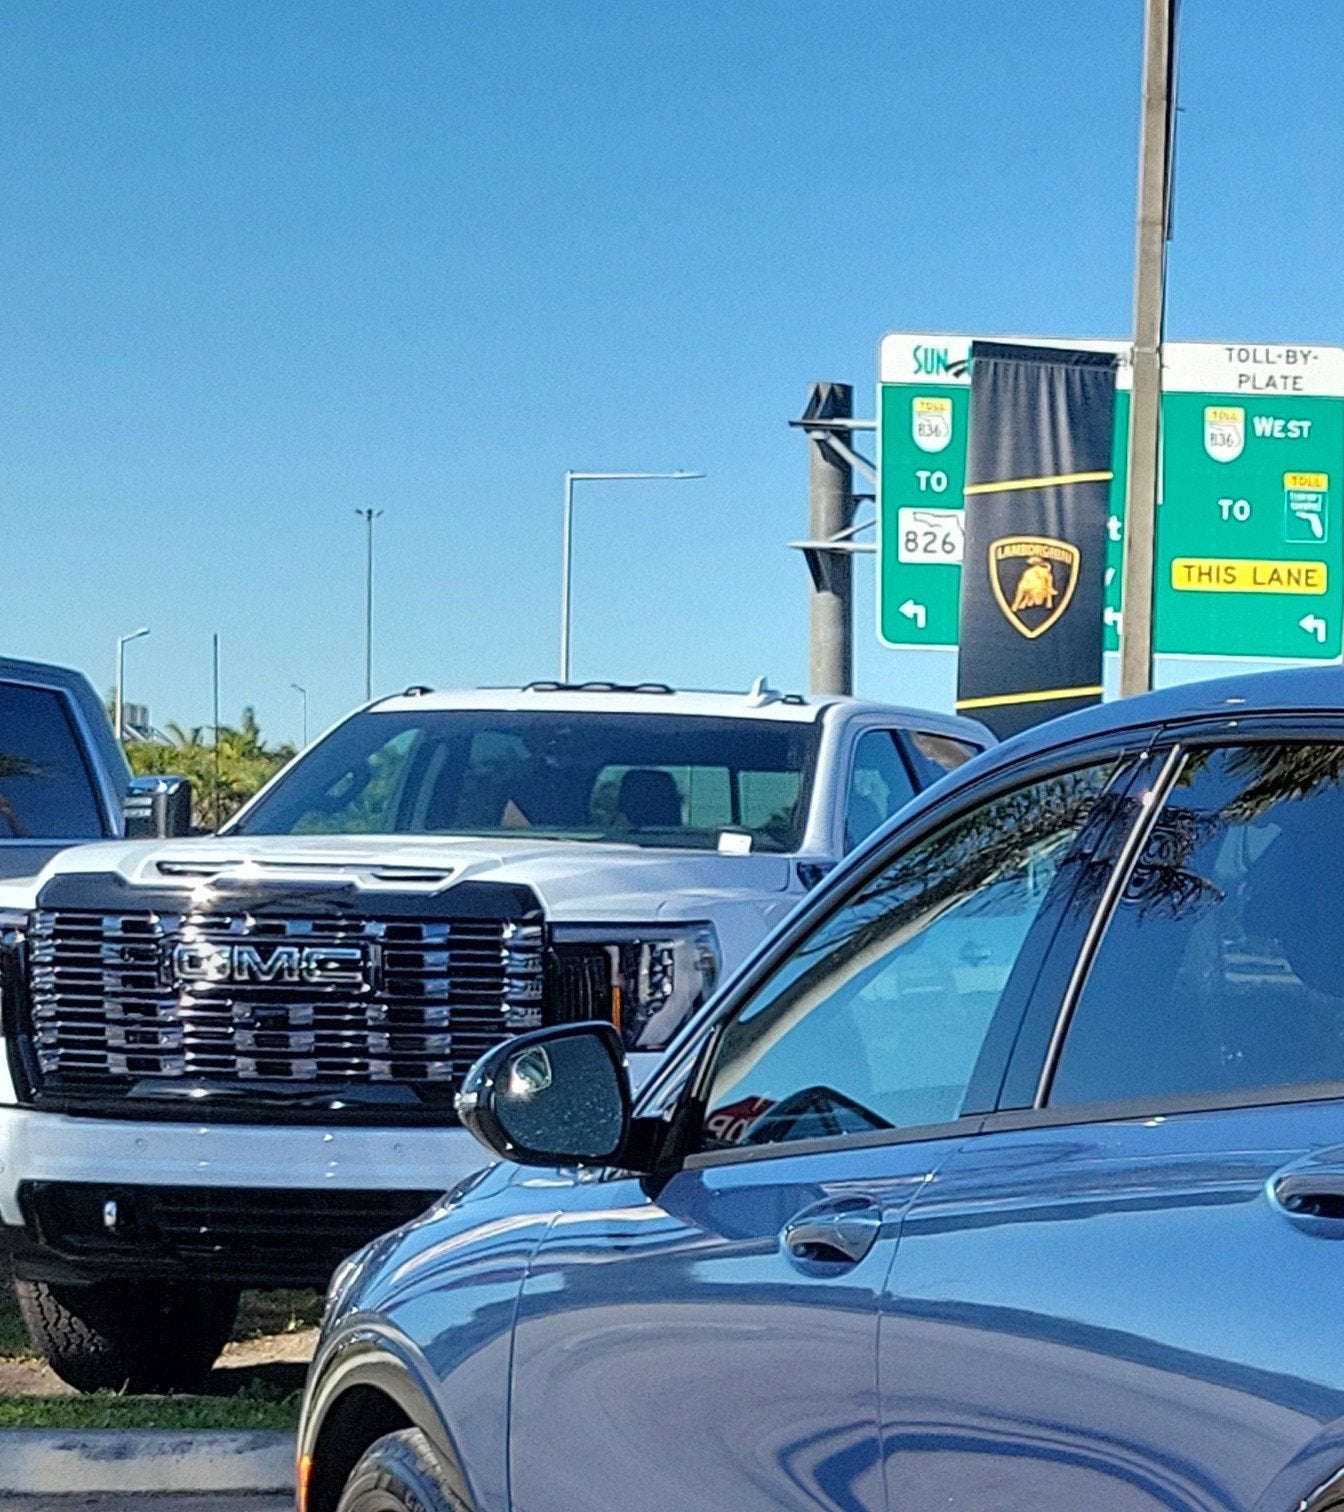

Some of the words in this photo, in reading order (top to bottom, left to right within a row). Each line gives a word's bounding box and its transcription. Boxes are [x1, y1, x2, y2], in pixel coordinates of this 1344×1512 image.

[1237, 373, 1304, 391] PLATE
[1252, 416, 1312, 439] WEST
[915, 470, 948, 493] TO
[1217, 498, 1251, 522] TO
[904, 531, 956, 554] 826
[1182, 564, 1237, 585] THIS
[1252, 566, 1319, 588] LANE
[172, 942, 364, 983] GMC
